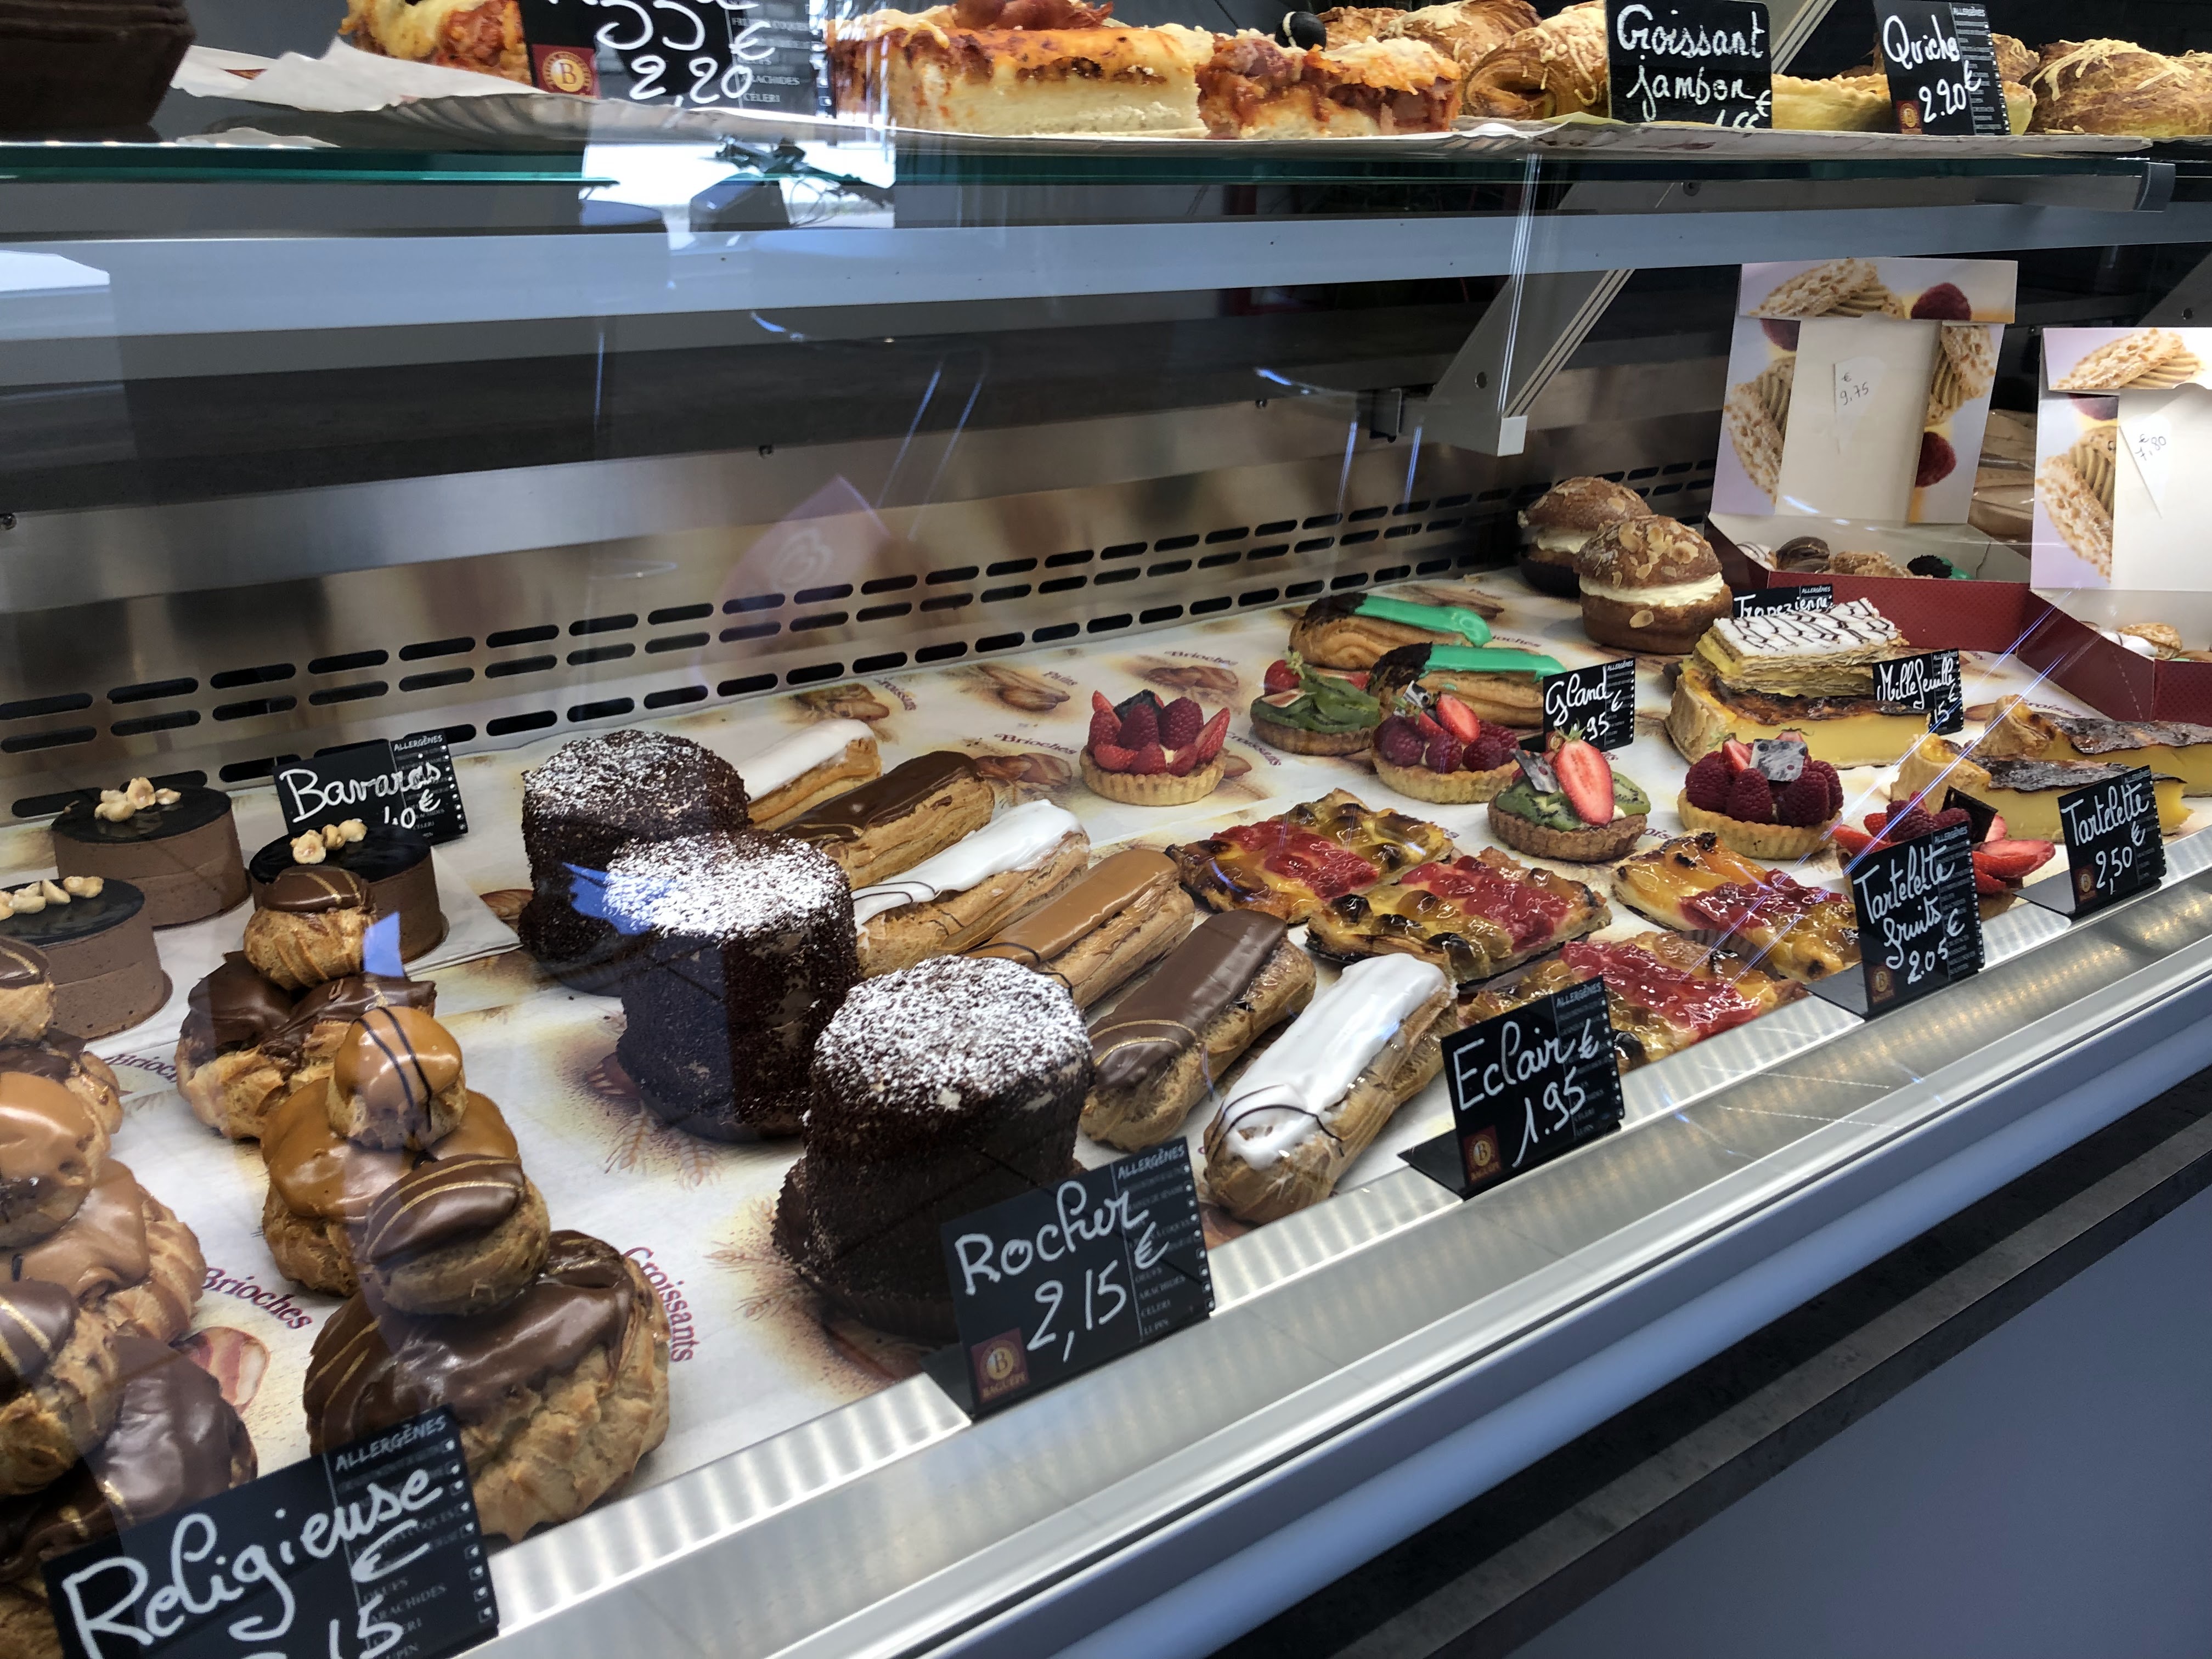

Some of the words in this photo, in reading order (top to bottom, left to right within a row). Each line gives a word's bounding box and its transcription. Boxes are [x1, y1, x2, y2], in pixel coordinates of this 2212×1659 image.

[1617, 4, 1765, 58] Croissant
[1883, 15, 1961, 70] Quiche
[629, 55, 753, 107] 2,20
[729, 21, 776, 60] €
[1626, 55, 1756, 122] jambon
[1918, 79, 1967, 123] 2.20
[1840, 382, 1869, 406] 9,75
[2135, 436, 2166, 461] 7,80
[1545, 666, 1614, 726] Gland
[394, 735, 443, 752] ALLERGÈNES
[994, 732, 1077, 755] Brioches
[419, 789, 441, 812] €
[2061, 783, 2149, 846] Tartelette
[1853, 845, 1955, 924] Tartelette
[2096, 846, 2132, 895] 2,50
[2131, 821, 2146, 846] €
[1883, 896, 1942, 969] fruits
[1908, 938, 1948, 984] 2.05
[1947, 908, 1965, 937] €
[1453, 1021, 1576, 1111] Eclair
[1512, 1066, 1585, 1168] 1.95
[955, 1181, 1149, 1295] Rocher
[202, 1267, 313, 1329] Brioches
[623, 1247, 700, 1362] Croissants
[1027, 1260, 1127, 1362] 2,15
[1134, 1222, 1170, 1269] €
[335, 1415, 447, 1472] ALLERGÈNES
[62, 1468, 443, 1659] Religieuse
[351, 1519, 430, 1583] €
